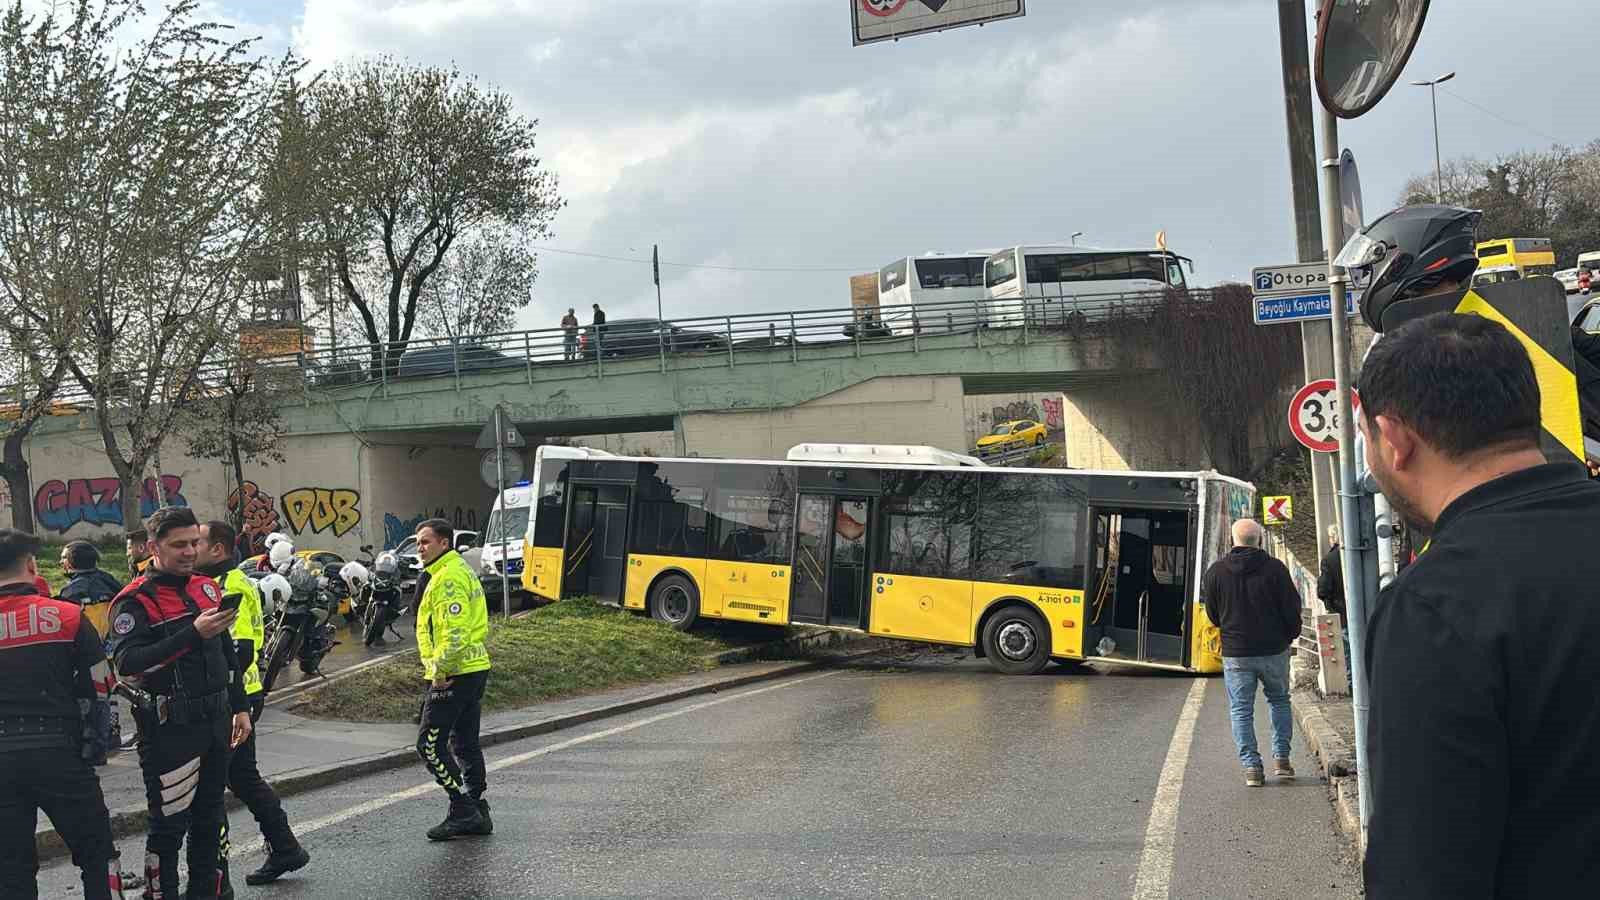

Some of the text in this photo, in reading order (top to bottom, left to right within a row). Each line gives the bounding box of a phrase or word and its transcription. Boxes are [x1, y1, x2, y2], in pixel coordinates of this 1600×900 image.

[1273, 272, 1327, 287] Otopa
[1259, 296, 1331, 318] Beyoğlu Kaymaka
